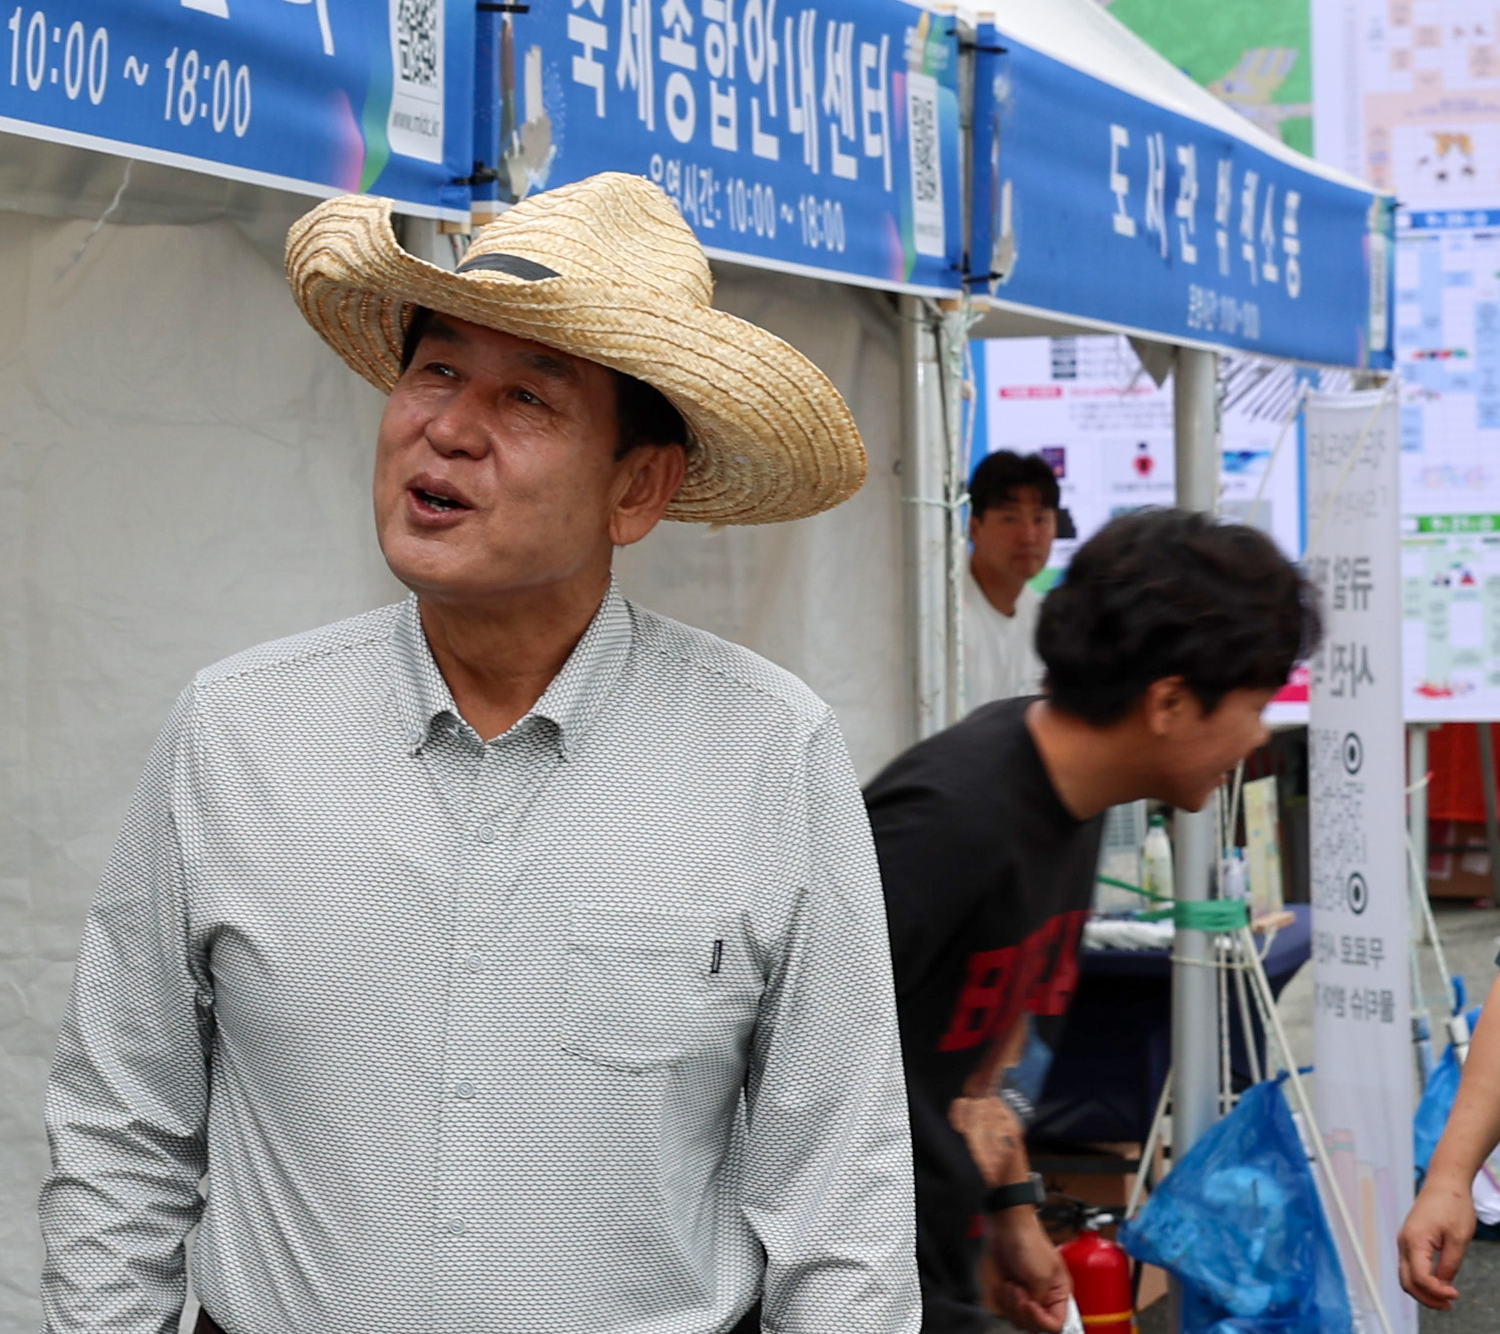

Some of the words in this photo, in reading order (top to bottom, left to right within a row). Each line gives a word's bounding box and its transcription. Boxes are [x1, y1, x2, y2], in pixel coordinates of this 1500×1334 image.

[6, 5, 109, 107] 10:00
[124, 54, 151, 90] ~
[163, 48, 252, 139] 18:00
[726, 177, 776, 239] 10:00
[799, 193, 846, 253] 18:00
[1110, 124, 1197, 265] 도서관
